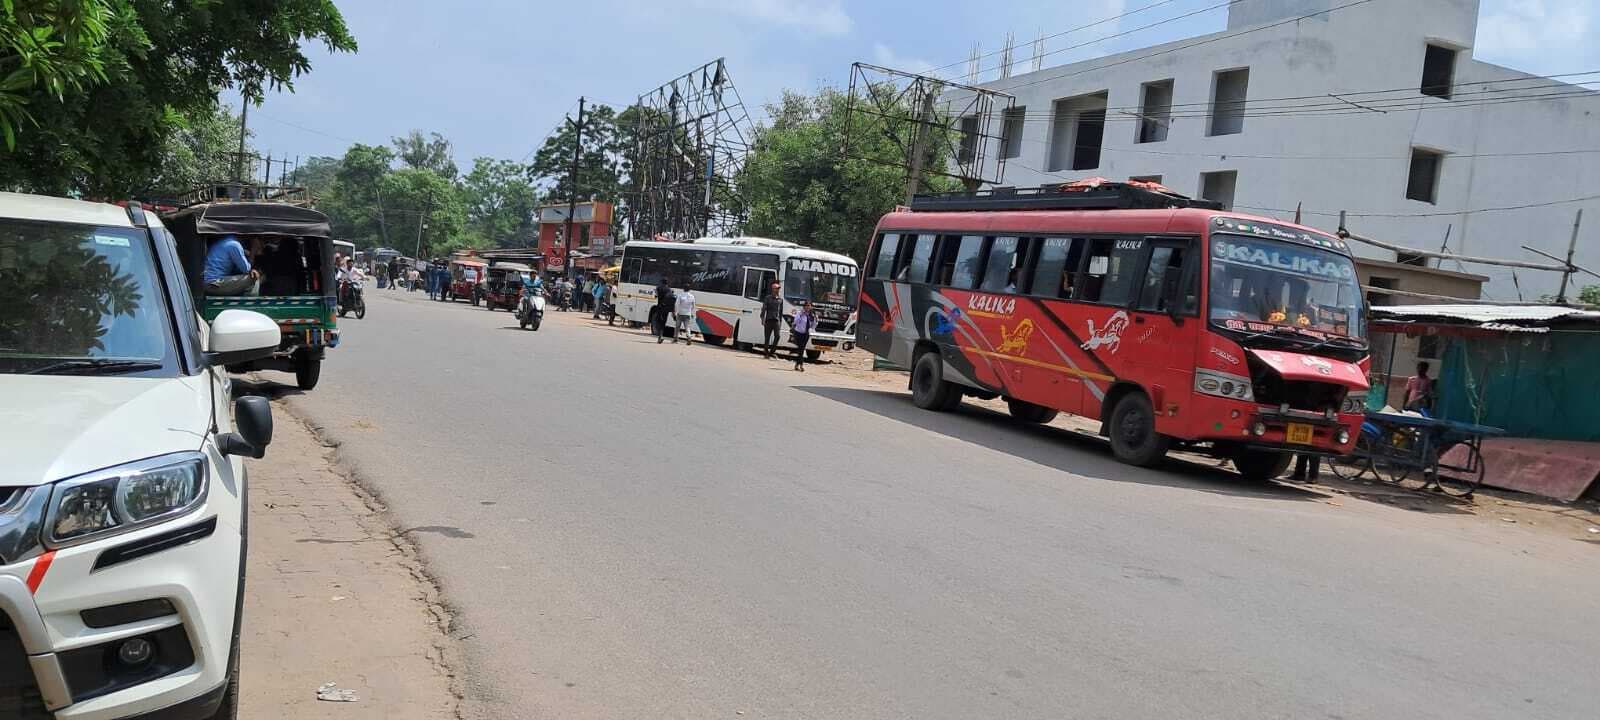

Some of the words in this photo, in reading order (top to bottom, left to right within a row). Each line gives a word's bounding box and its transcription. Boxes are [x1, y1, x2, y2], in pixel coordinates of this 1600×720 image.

[1115, 240, 1142, 249] KALIKA
[791, 259, 857, 277] MANOJ
[1228, 244, 1342, 277] KALIKA
[968, 294, 1016, 314] KALIKA
